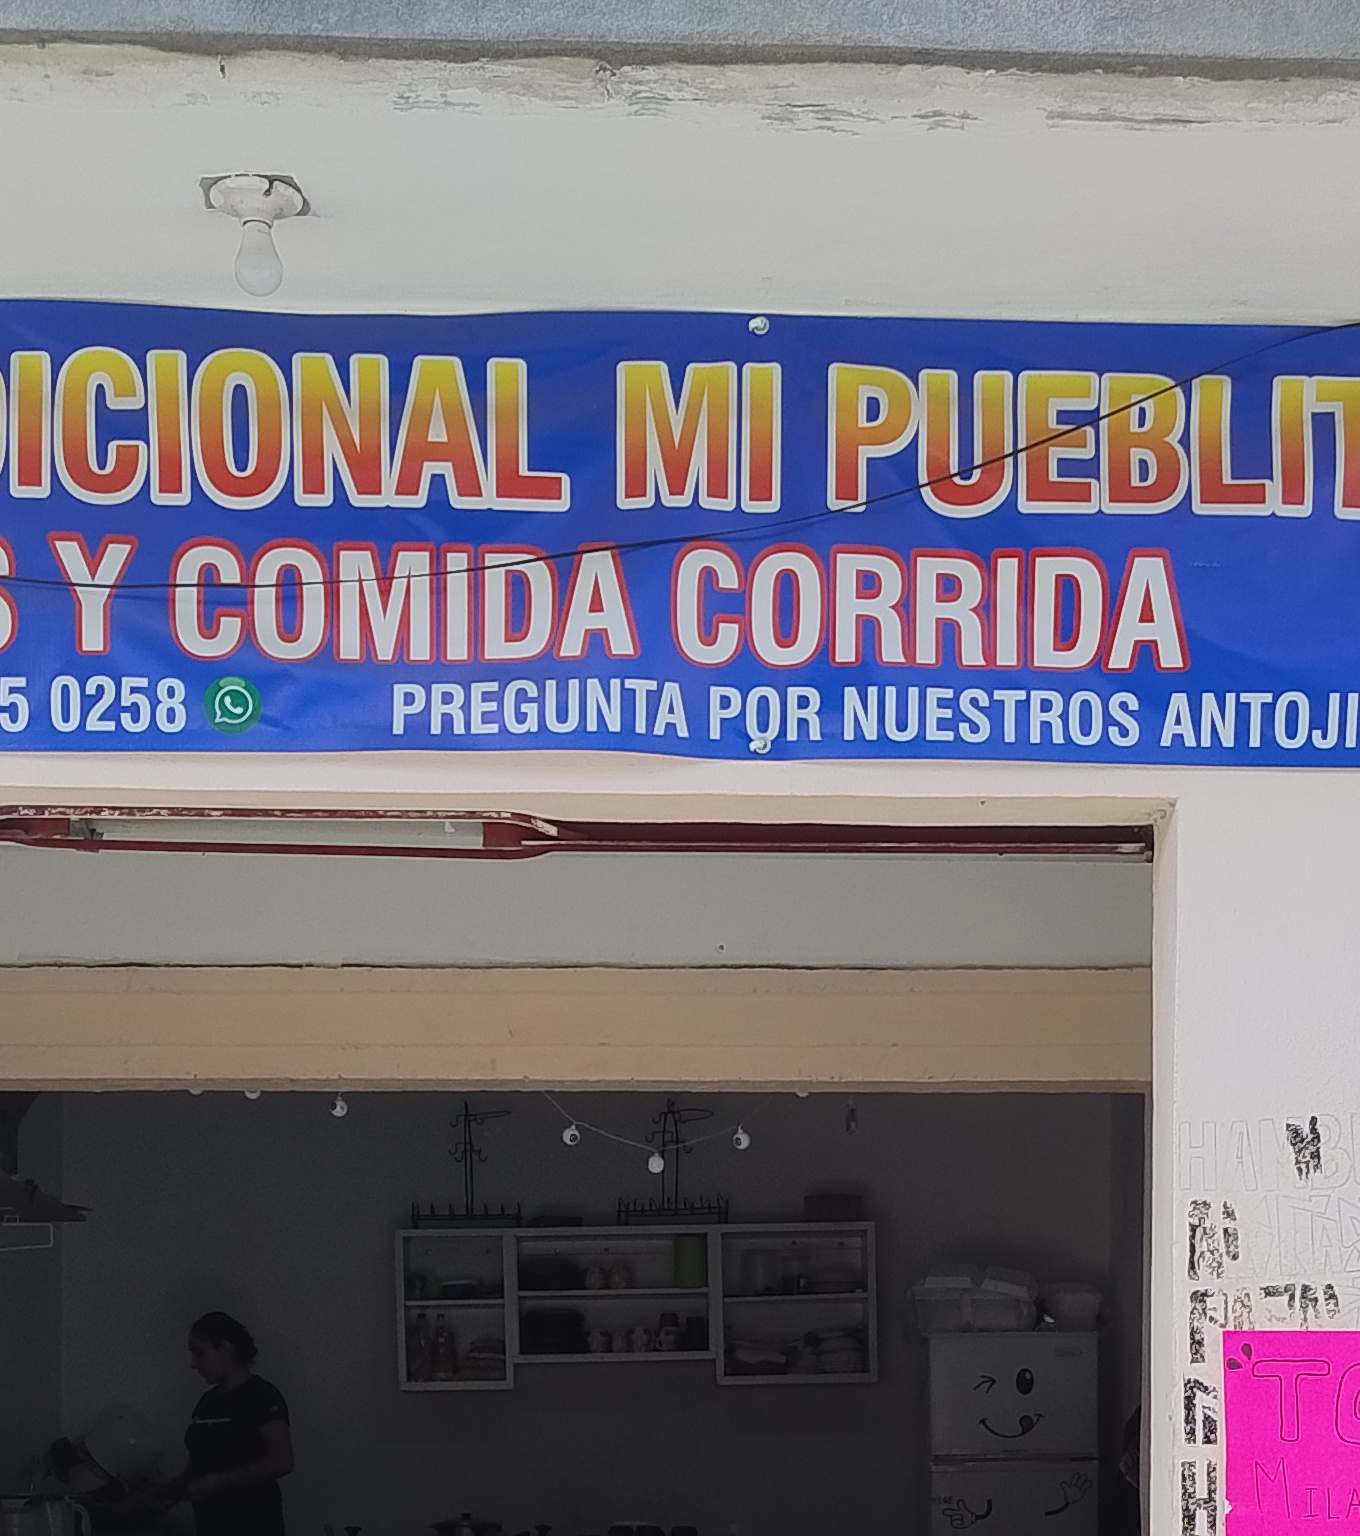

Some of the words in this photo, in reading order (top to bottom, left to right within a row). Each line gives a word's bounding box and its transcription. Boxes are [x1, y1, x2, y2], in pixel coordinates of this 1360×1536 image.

[617, 361, 781, 513] MI
[52, 532, 138, 655] Y
[169, 537, 640, 664] COMIDA
[671, 541, 1190, 672] CORRIDA
[51, 676, 186, 732] 0258
[393, 679, 689, 737] PREGUNTA
[707, 687, 822, 748] POR
[844, 686, 1139, 746] NUESTROS
